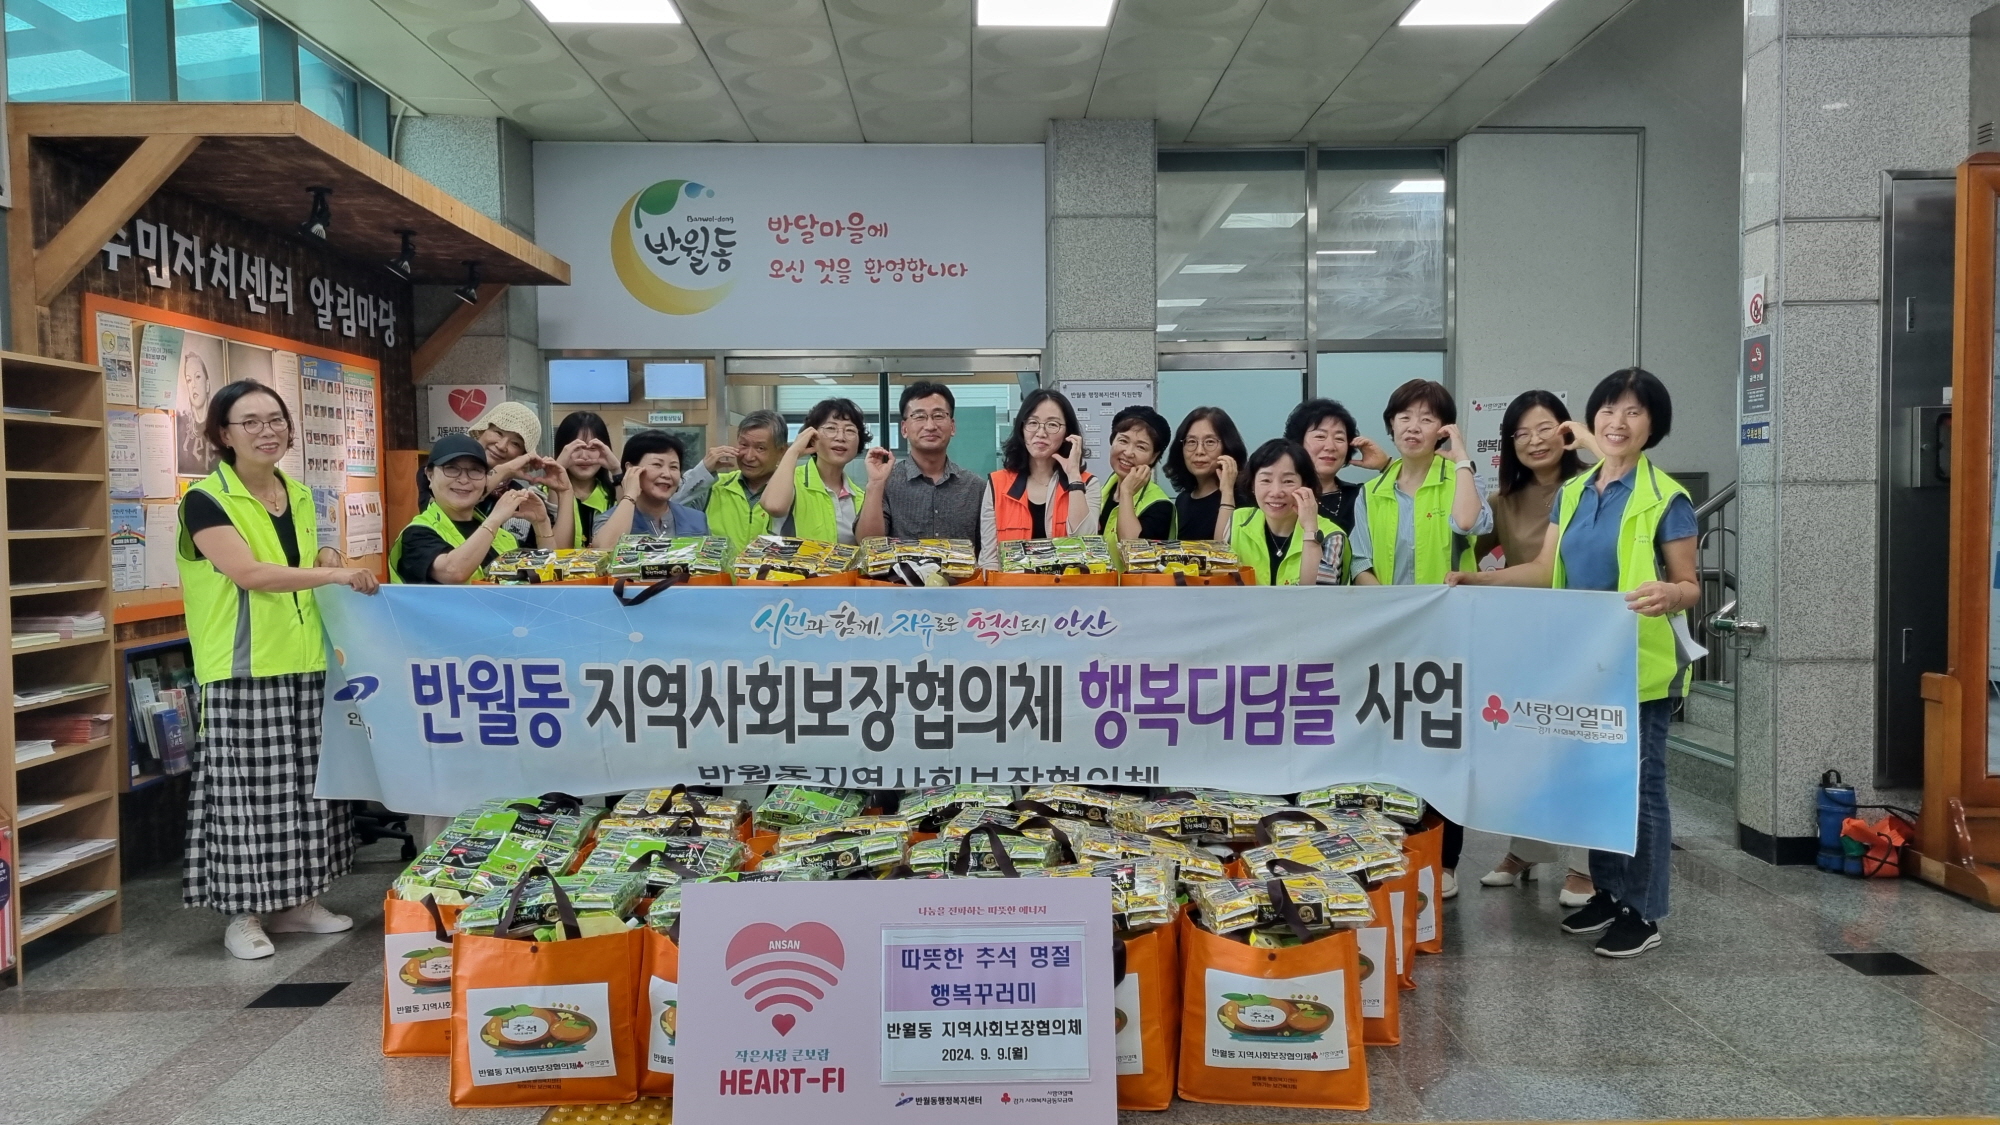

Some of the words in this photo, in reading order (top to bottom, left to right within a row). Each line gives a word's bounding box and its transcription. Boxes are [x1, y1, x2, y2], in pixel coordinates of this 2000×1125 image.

[686, 214, 734, 224] Banwol-dong
[767, 211, 888, 245] 반달마을에
[643, 225, 737, 276] 반월동
[768, 258, 806, 283] 오신
[814, 257, 852, 284] 것을
[864, 257, 968, 283] 환영합니다
[100, 218, 294, 315] 주민자치센터
[309, 276, 397, 348] 알림마당
[754, 602, 829, 646] 시민과
[888, 613, 960, 647] 자유로운
[967, 611, 1047, 645] 혁신도시
[1053, 609, 1119, 638] 안산
[410, 659, 570, 748] 반월동
[584, 660, 1063, 752] 지역사회보장협의체
[1078, 660, 1341, 749] 행복디딤돌
[1354, 660, 1463, 750] 사업
[1512, 701, 1623, 729] 사랑의열매
[1538, 726, 1551, 735] 경기
[1552, 728, 1624, 740] 사회복지공동모금회
[918, 906, 945, 916] 나눔을
[987, 906, 1016, 915] 따뜻한
[1018, 905, 1047, 915] 에너지
[768, 940, 801, 951] ANSAN
[901, 947, 964, 971] 따뜻한
[976, 946, 1017, 969] 추석
[1030, 945, 1071, 969] 명절
[930, 981, 1036, 1007] 행복꾸러미
[396, 1005, 420, 1015] 반월동
[886, 1022, 933, 1040] 반월동
[941, 1018, 1082, 1038] 지역사회보장협의체
[653, 1052, 674, 1065] 반월동
[734, 1048, 788, 1063] 작은사랑
[791, 1048, 830, 1062] 큰보람
[941, 1048, 974, 1062] 2024.
[980, 1048, 991, 1061] 9.
[1211, 1048, 1236, 1058] 반월동
[1238, 1049, 1312, 1061] 지역사회보장협의체
[478, 1067, 503, 1078] 반월동
[504, 1061, 578, 1075] 지역사회보장협의체
[719, 1067, 845, 1096] HEART-FI
[914, 1096, 983, 1106] 반월동행정복지센터
